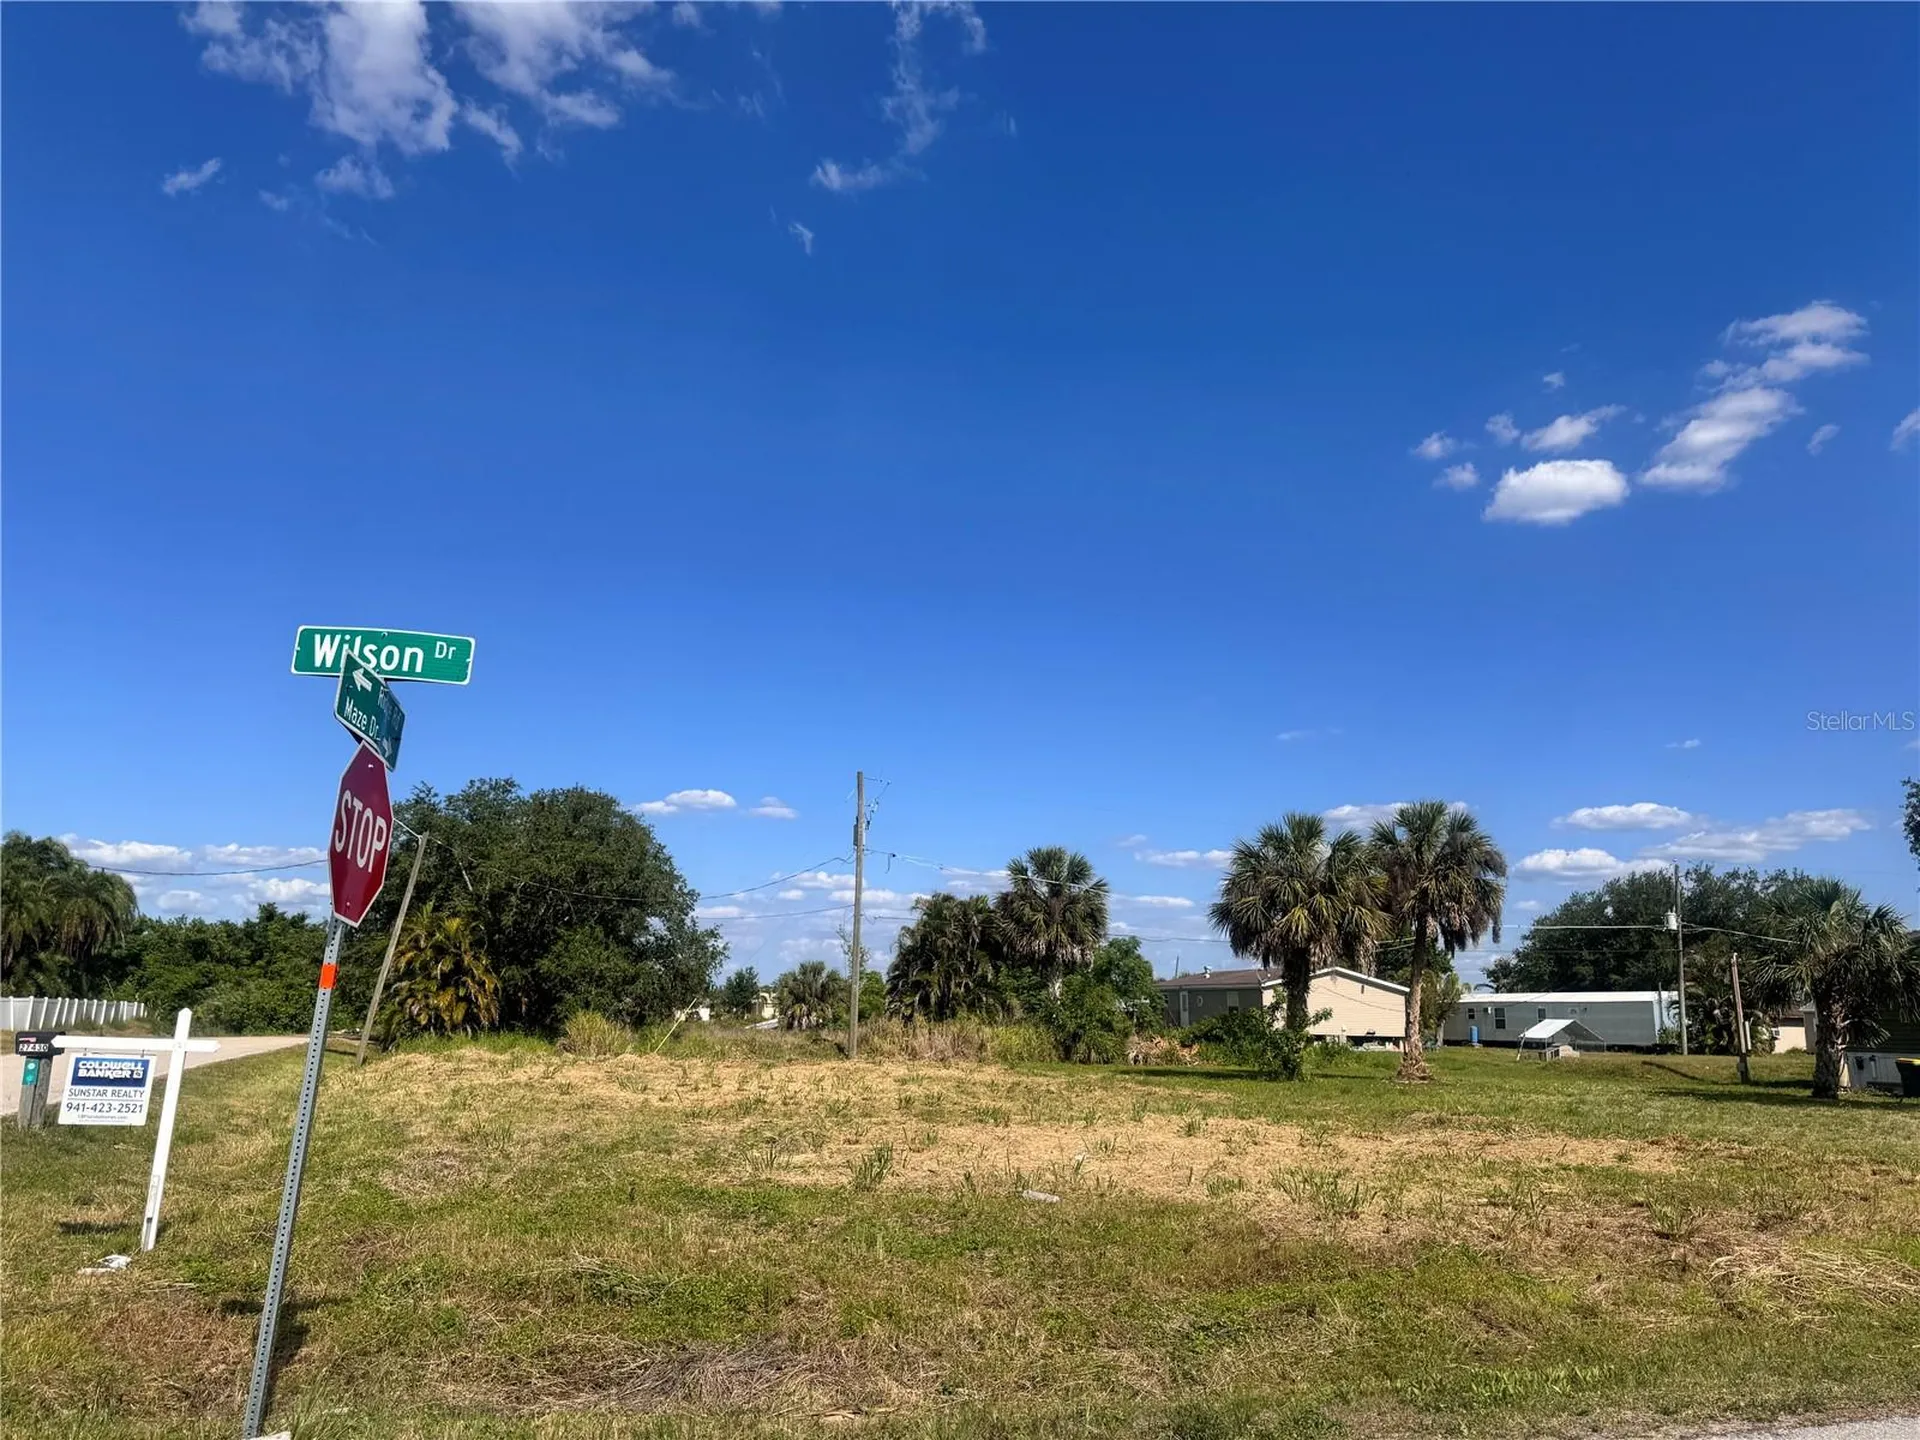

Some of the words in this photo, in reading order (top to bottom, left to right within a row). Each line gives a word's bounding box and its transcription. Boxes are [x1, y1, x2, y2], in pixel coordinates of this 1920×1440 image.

[314, 634, 424, 673] Wilson
[434, 641, 456, 660] Dr
[344, 696, 368, 731] Maze
[335, 789, 387, 873] STOP
[66, 1101, 144, 1114] 941-423-2521
[68, 1087, 108, 1099] SUNSTAR
[110, 1089, 145, 1099] REALTY
